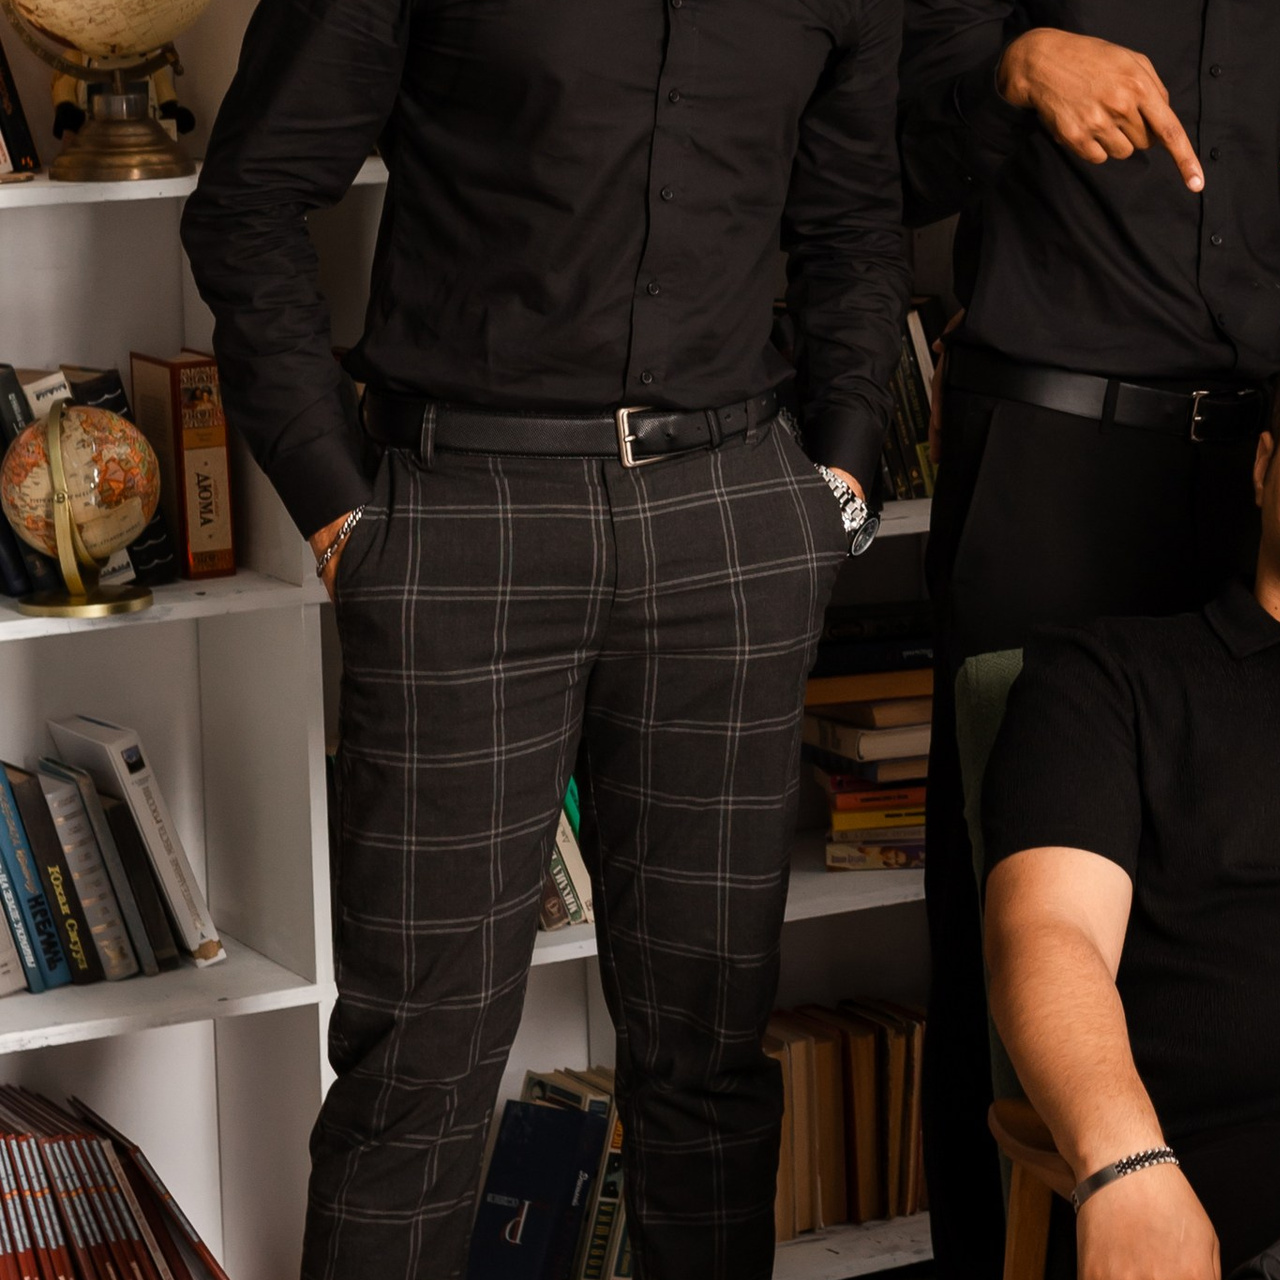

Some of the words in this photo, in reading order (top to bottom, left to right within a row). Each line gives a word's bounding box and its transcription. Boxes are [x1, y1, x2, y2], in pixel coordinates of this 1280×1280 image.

[195, 472, 215, 528] ДЮМА
[13, 919, 36, 970] УКРАИНЫ
[27, 894, 64, 971] КРЕМЛЬ
[46, 865, 71, 916] Юхан
[64, 918, 88, 970] Смуул
[585, 1203, 615, 1277] ЛОВУШКА
